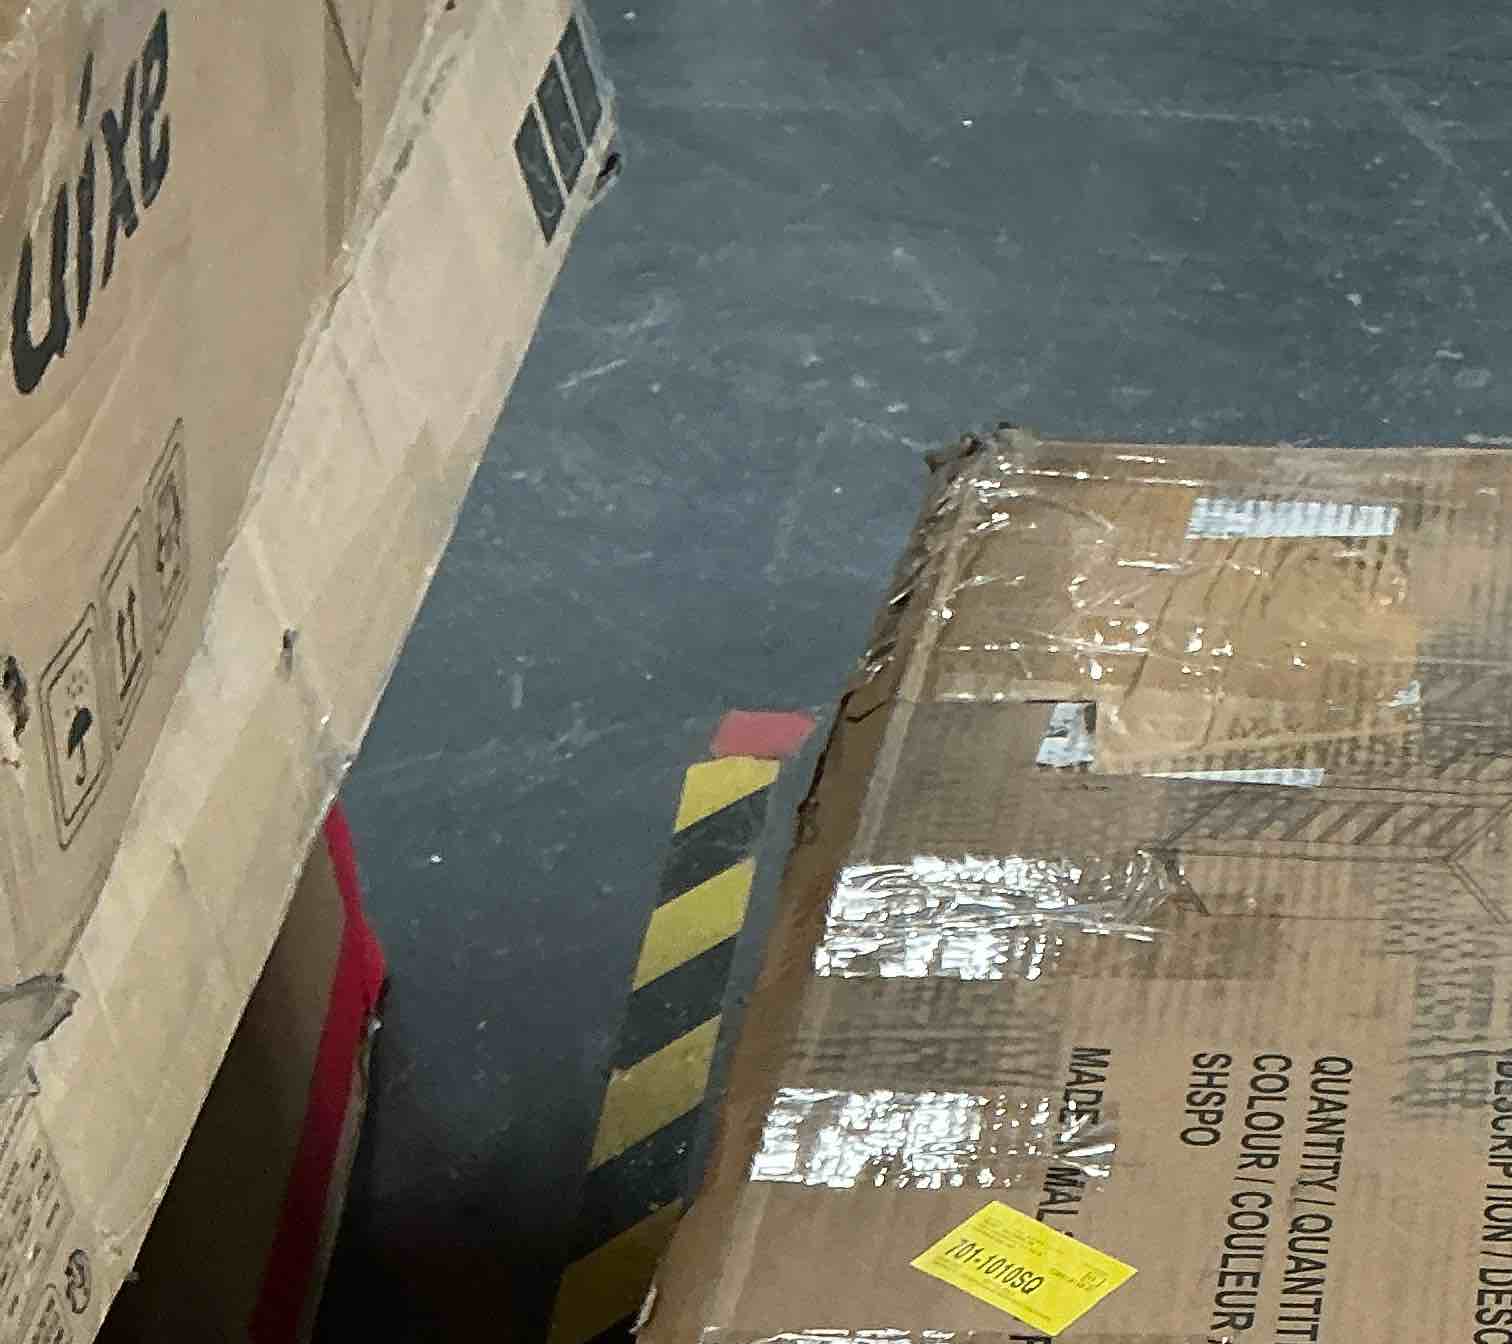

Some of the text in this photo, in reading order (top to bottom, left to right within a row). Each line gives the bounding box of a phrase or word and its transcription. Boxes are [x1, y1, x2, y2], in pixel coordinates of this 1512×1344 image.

[1059, 1048, 1111, 1125] MADE
[1179, 1052, 1233, 1147] SHSPO
[1237, 1053, 1292, 1171] COLOUR
[1298, 1056, 1353, 1193] QUANTITY
[1211, 1191, 1272, 1333] COULEUR
